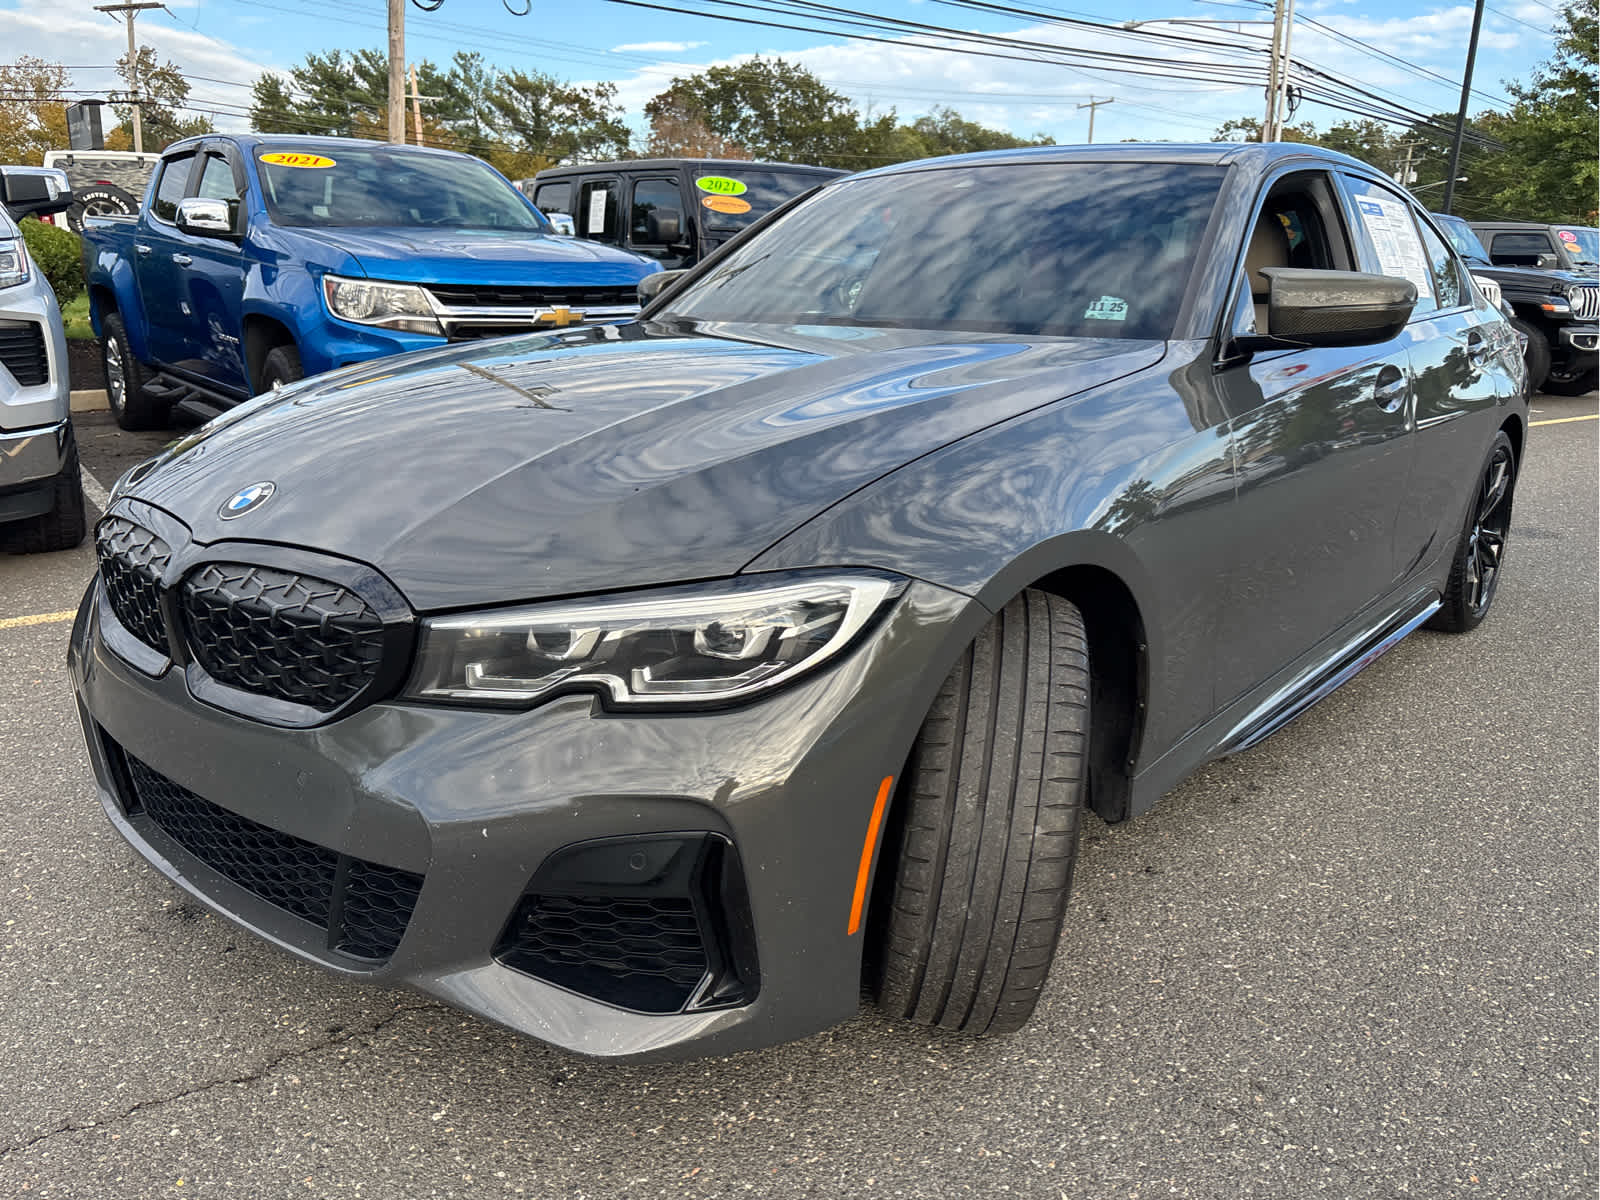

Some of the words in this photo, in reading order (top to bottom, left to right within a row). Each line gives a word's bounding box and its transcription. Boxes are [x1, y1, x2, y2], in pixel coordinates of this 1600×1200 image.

[274, 155, 321, 165] 2021
[706, 180, 736, 192] 2021
[1090, 302, 1105, 311] 11
[1109, 302, 1124, 312] 25
